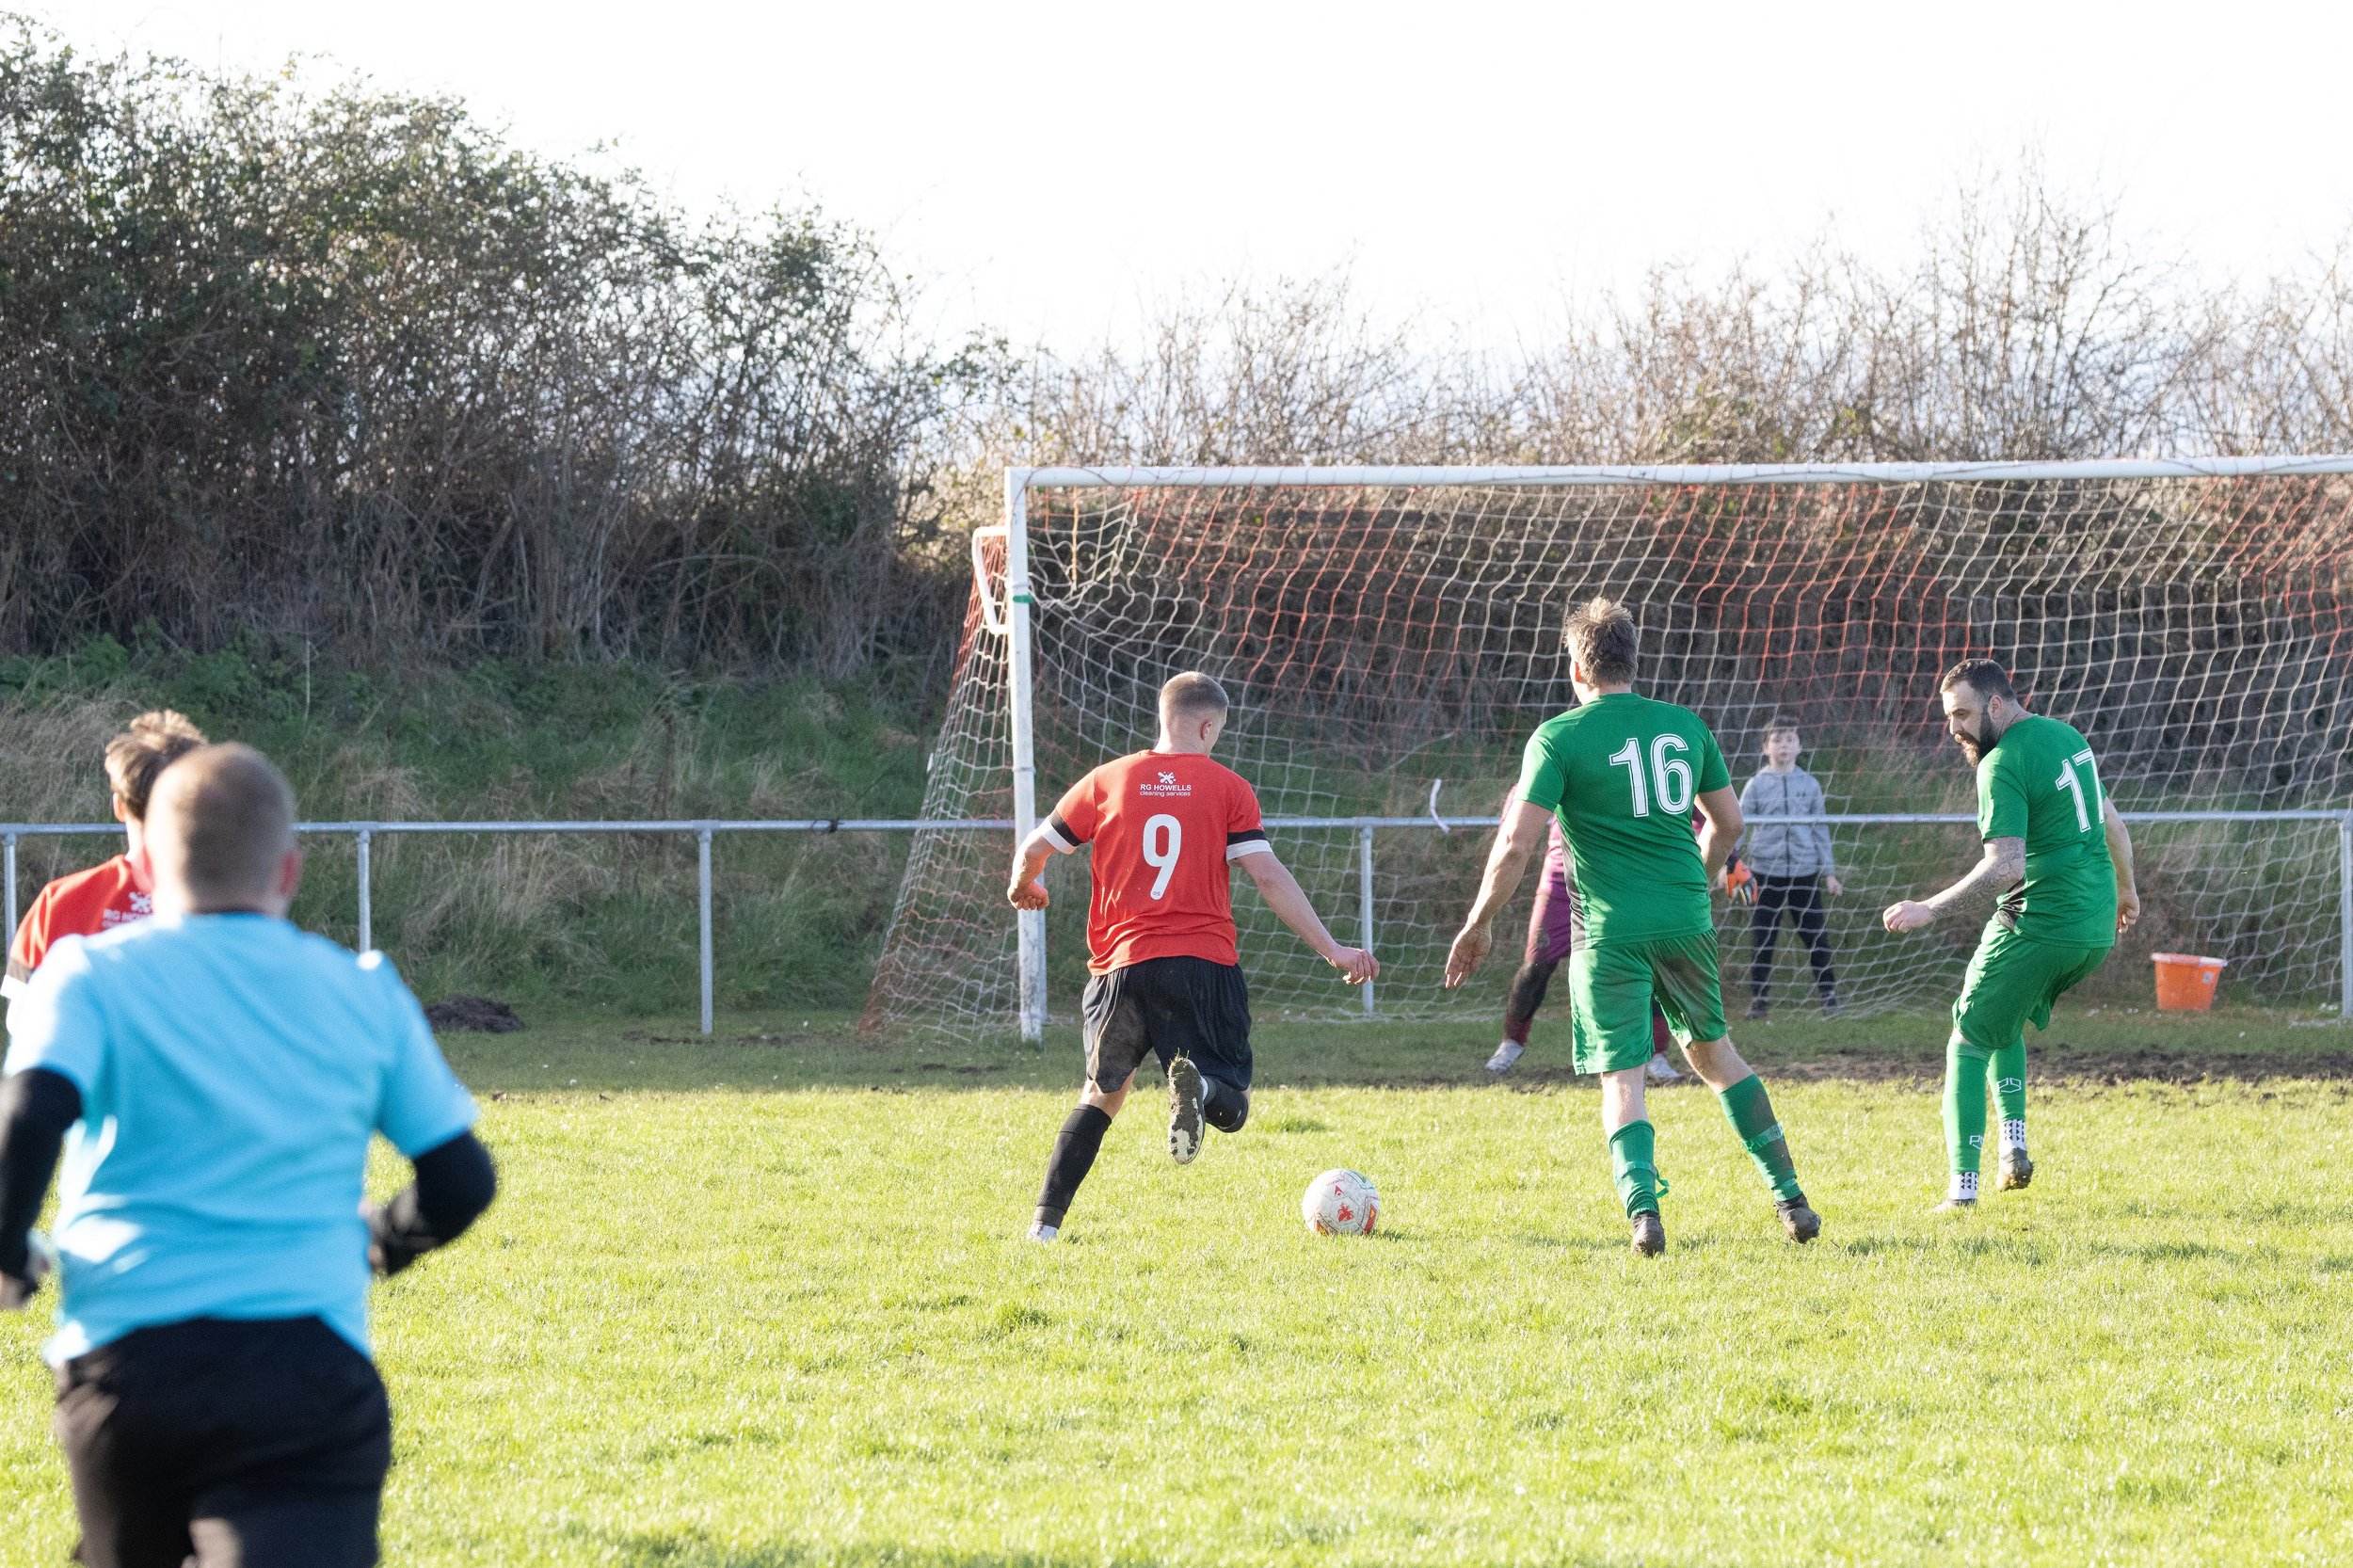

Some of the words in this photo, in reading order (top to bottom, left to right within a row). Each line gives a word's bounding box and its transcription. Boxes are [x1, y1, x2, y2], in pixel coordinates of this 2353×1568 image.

[1609, 733, 1693, 818] 16
[2055, 747, 2105, 833] 17
[1143, 813, 1182, 901] 9
